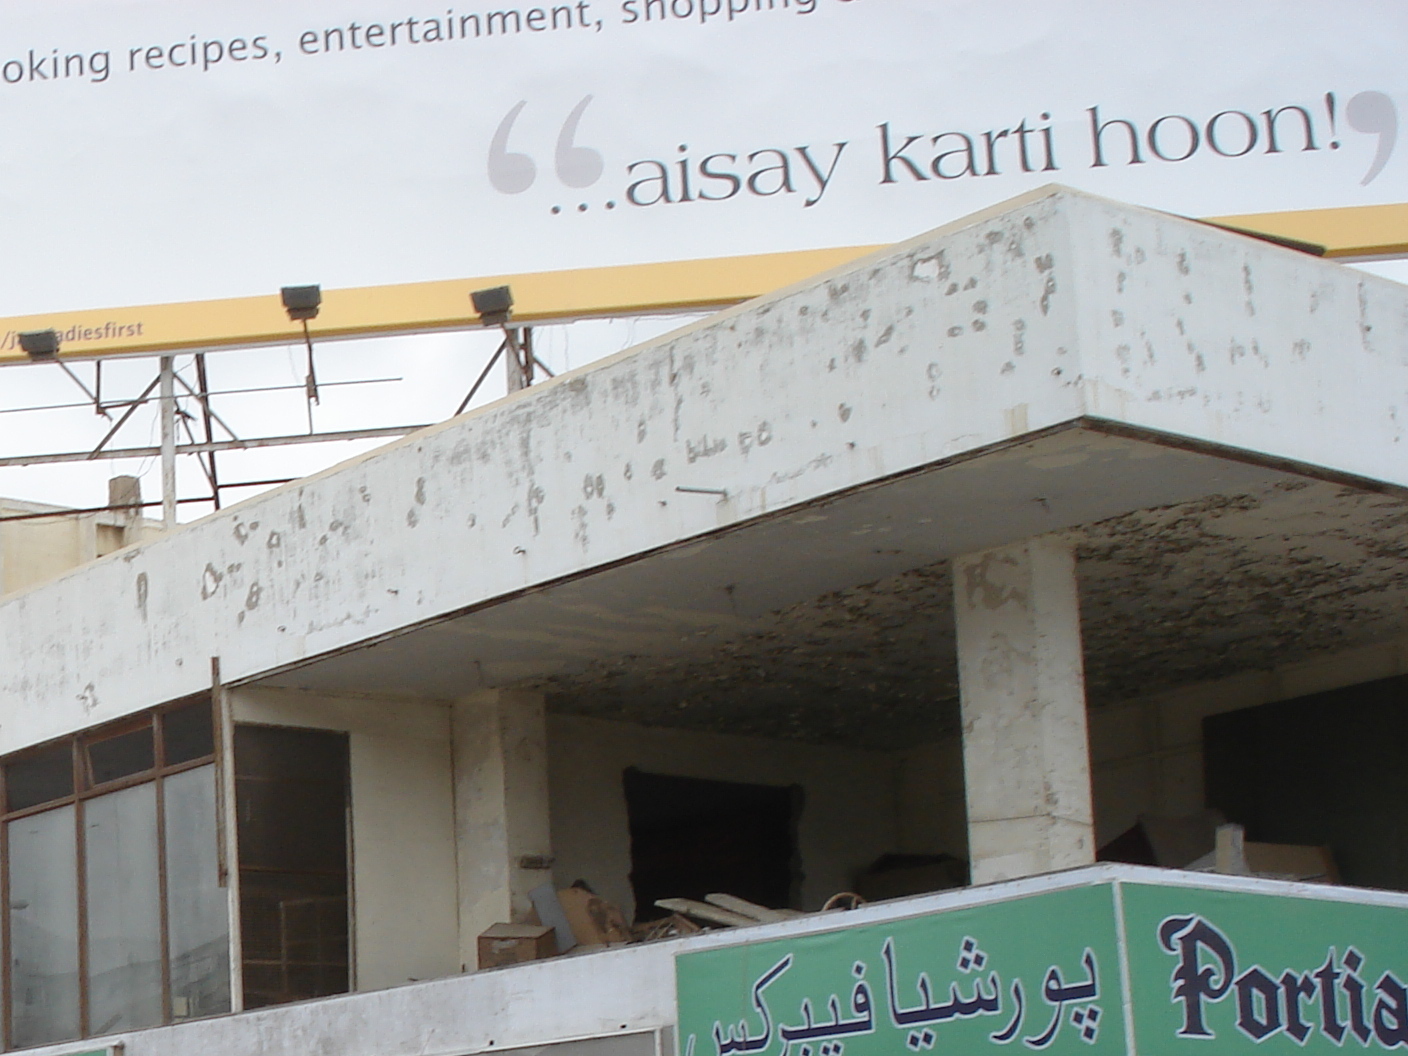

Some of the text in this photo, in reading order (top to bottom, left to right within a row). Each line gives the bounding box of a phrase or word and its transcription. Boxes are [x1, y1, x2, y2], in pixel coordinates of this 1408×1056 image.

[128, 35, 282, 72] recipes,
[299, 1, 603, 56] entertainment,
[878, 111, 1060, 185] karti
[1085, 91, 1342, 169] hoon!
[882, 936, 1103, 1050] پورشیا
[1156, 912, 1408, 1050] Portia
